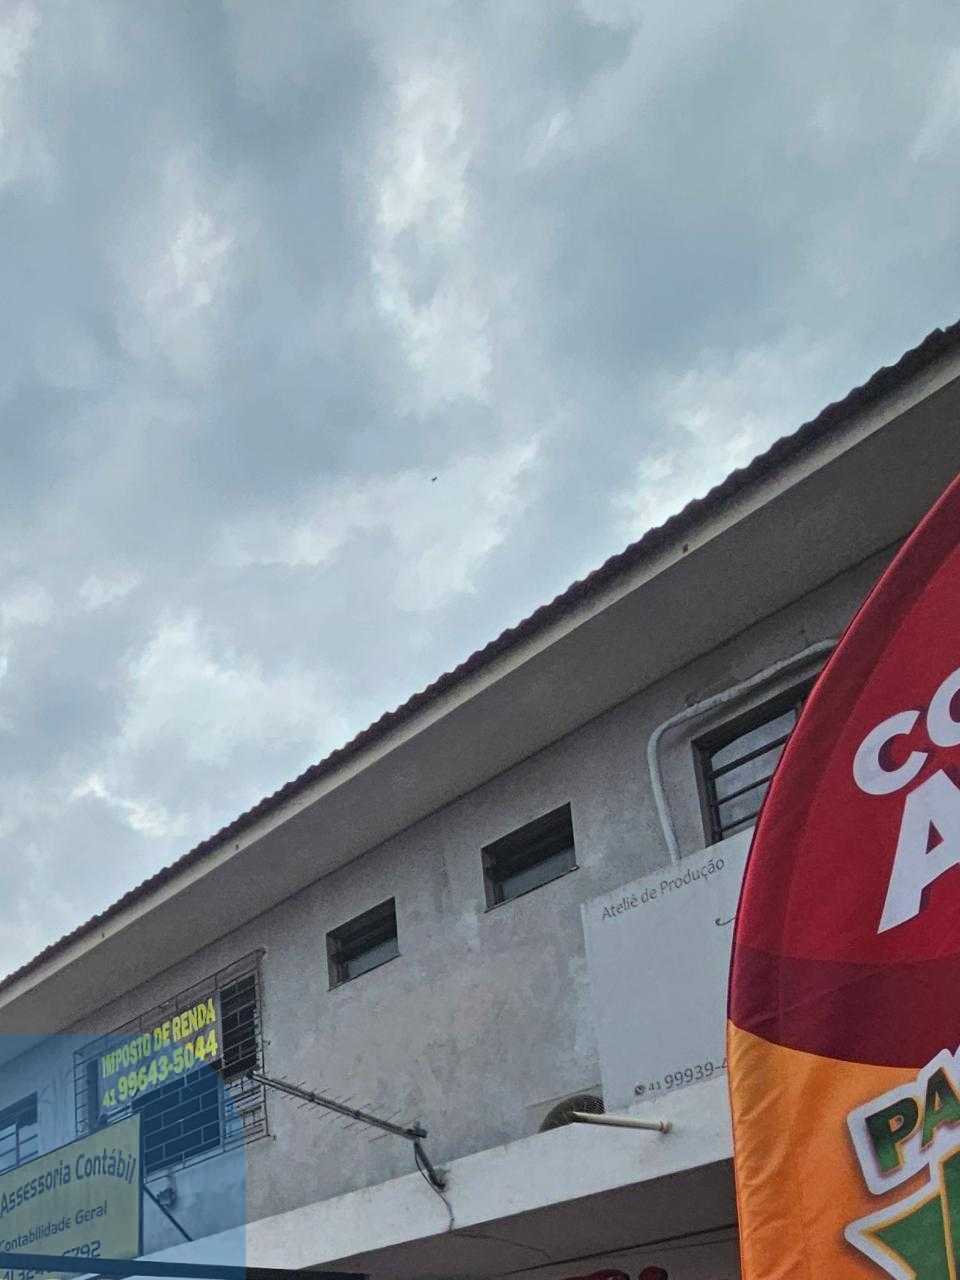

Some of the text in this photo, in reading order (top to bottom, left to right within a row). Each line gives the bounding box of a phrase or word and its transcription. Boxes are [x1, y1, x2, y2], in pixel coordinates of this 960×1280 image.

[641, 888, 657, 905] de
[660, 858, 725, 894] Produção
[101, 998, 217, 1079] IMPOSTO DE RENDA
[0, 1160, 71, 1218] Assessoria
[75, 1147, 137, 1184] Contábil
[0, 1200, 108, 1253] Contabilidade Geral
